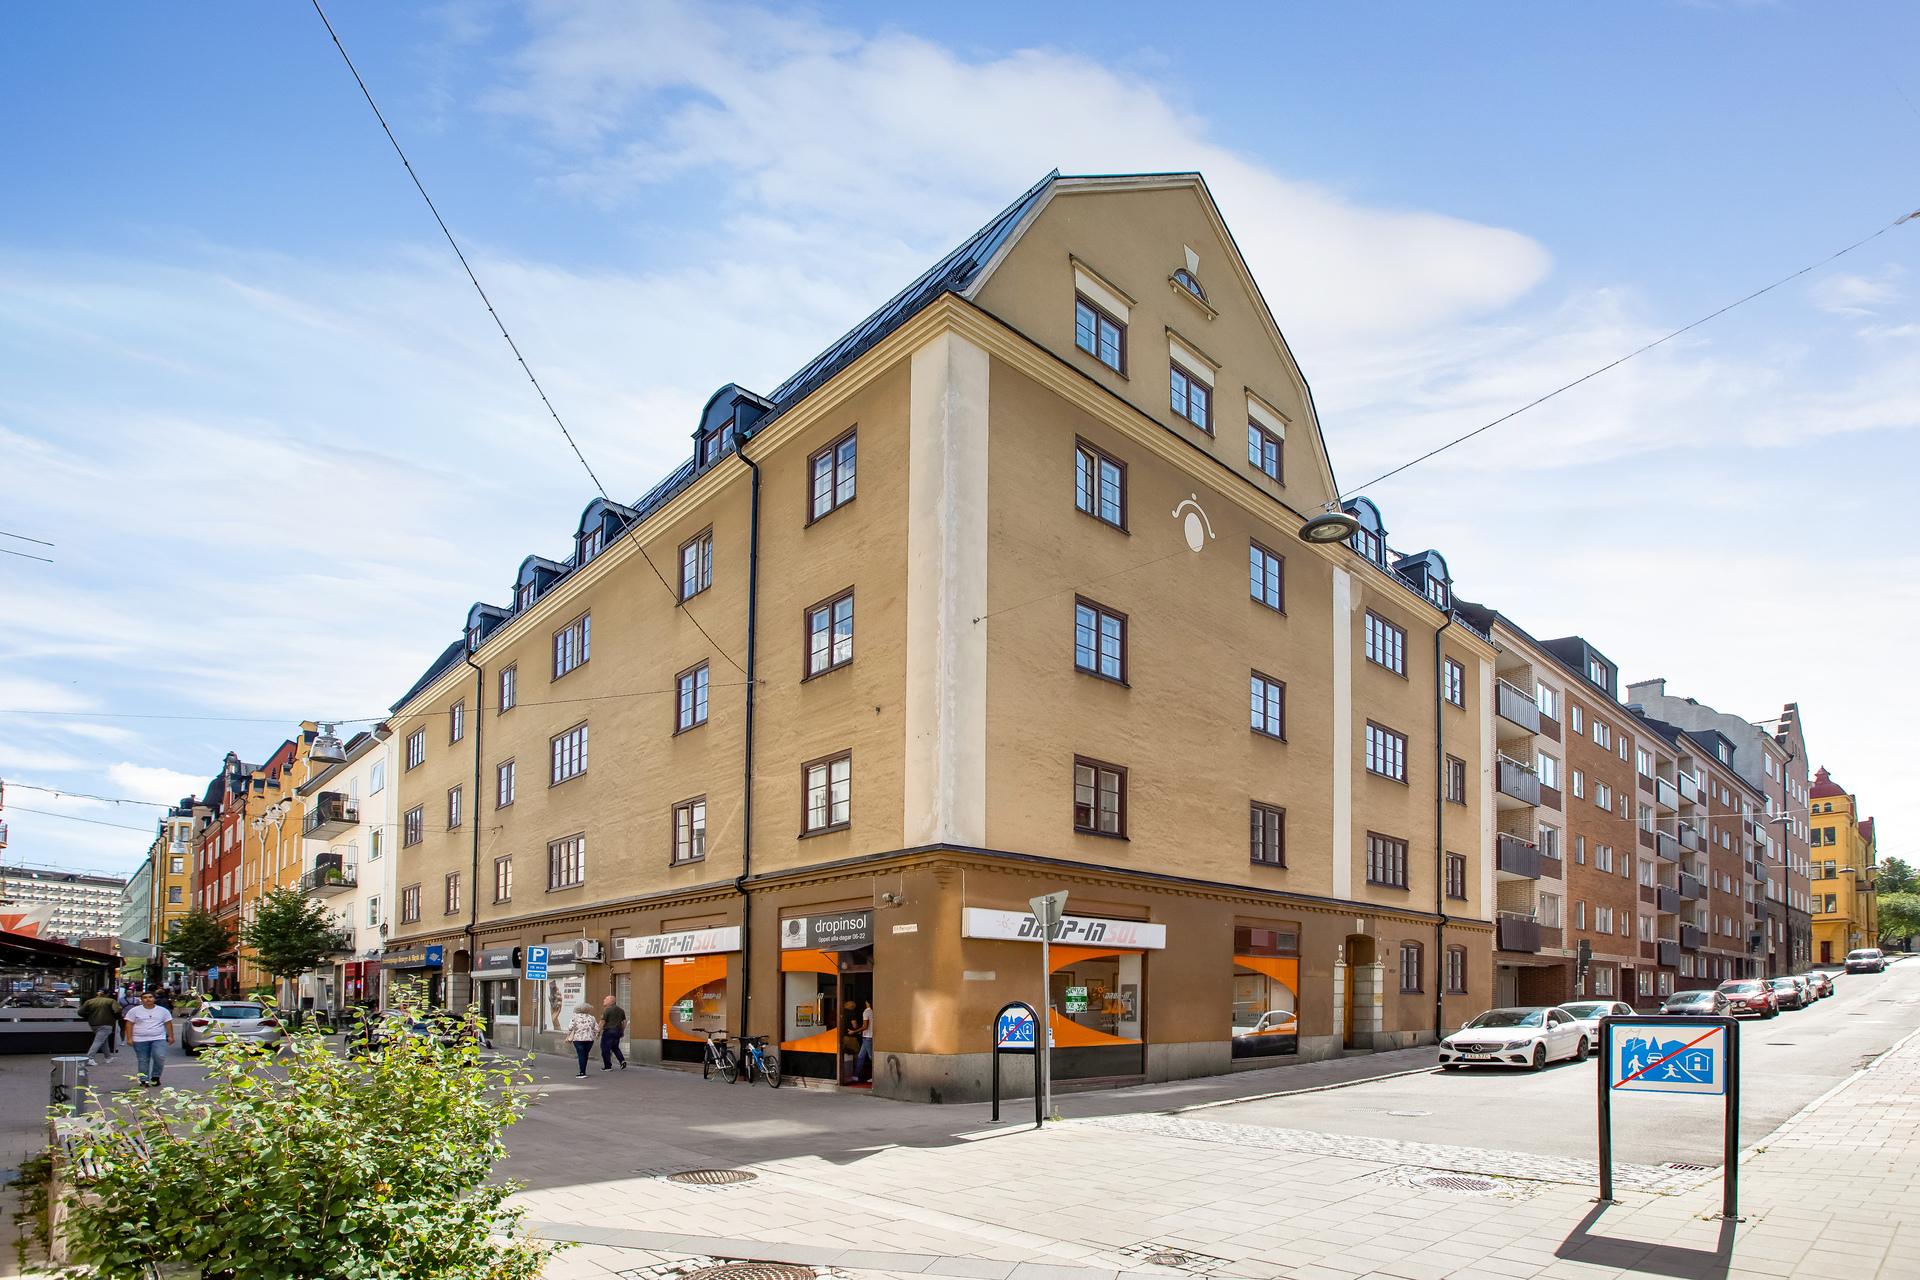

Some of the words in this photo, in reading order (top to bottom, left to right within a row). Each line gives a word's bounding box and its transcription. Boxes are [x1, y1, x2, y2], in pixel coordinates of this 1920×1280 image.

[815, 914, 867, 935] dropinsol
[1018, 917, 1107, 941] DOP-IN
[1105, 924, 1137, 944] SOL
[645, 934, 695, 955] DROP-IN
[693, 933, 717, 951] SOL
[532, 948, 545, 962] P
